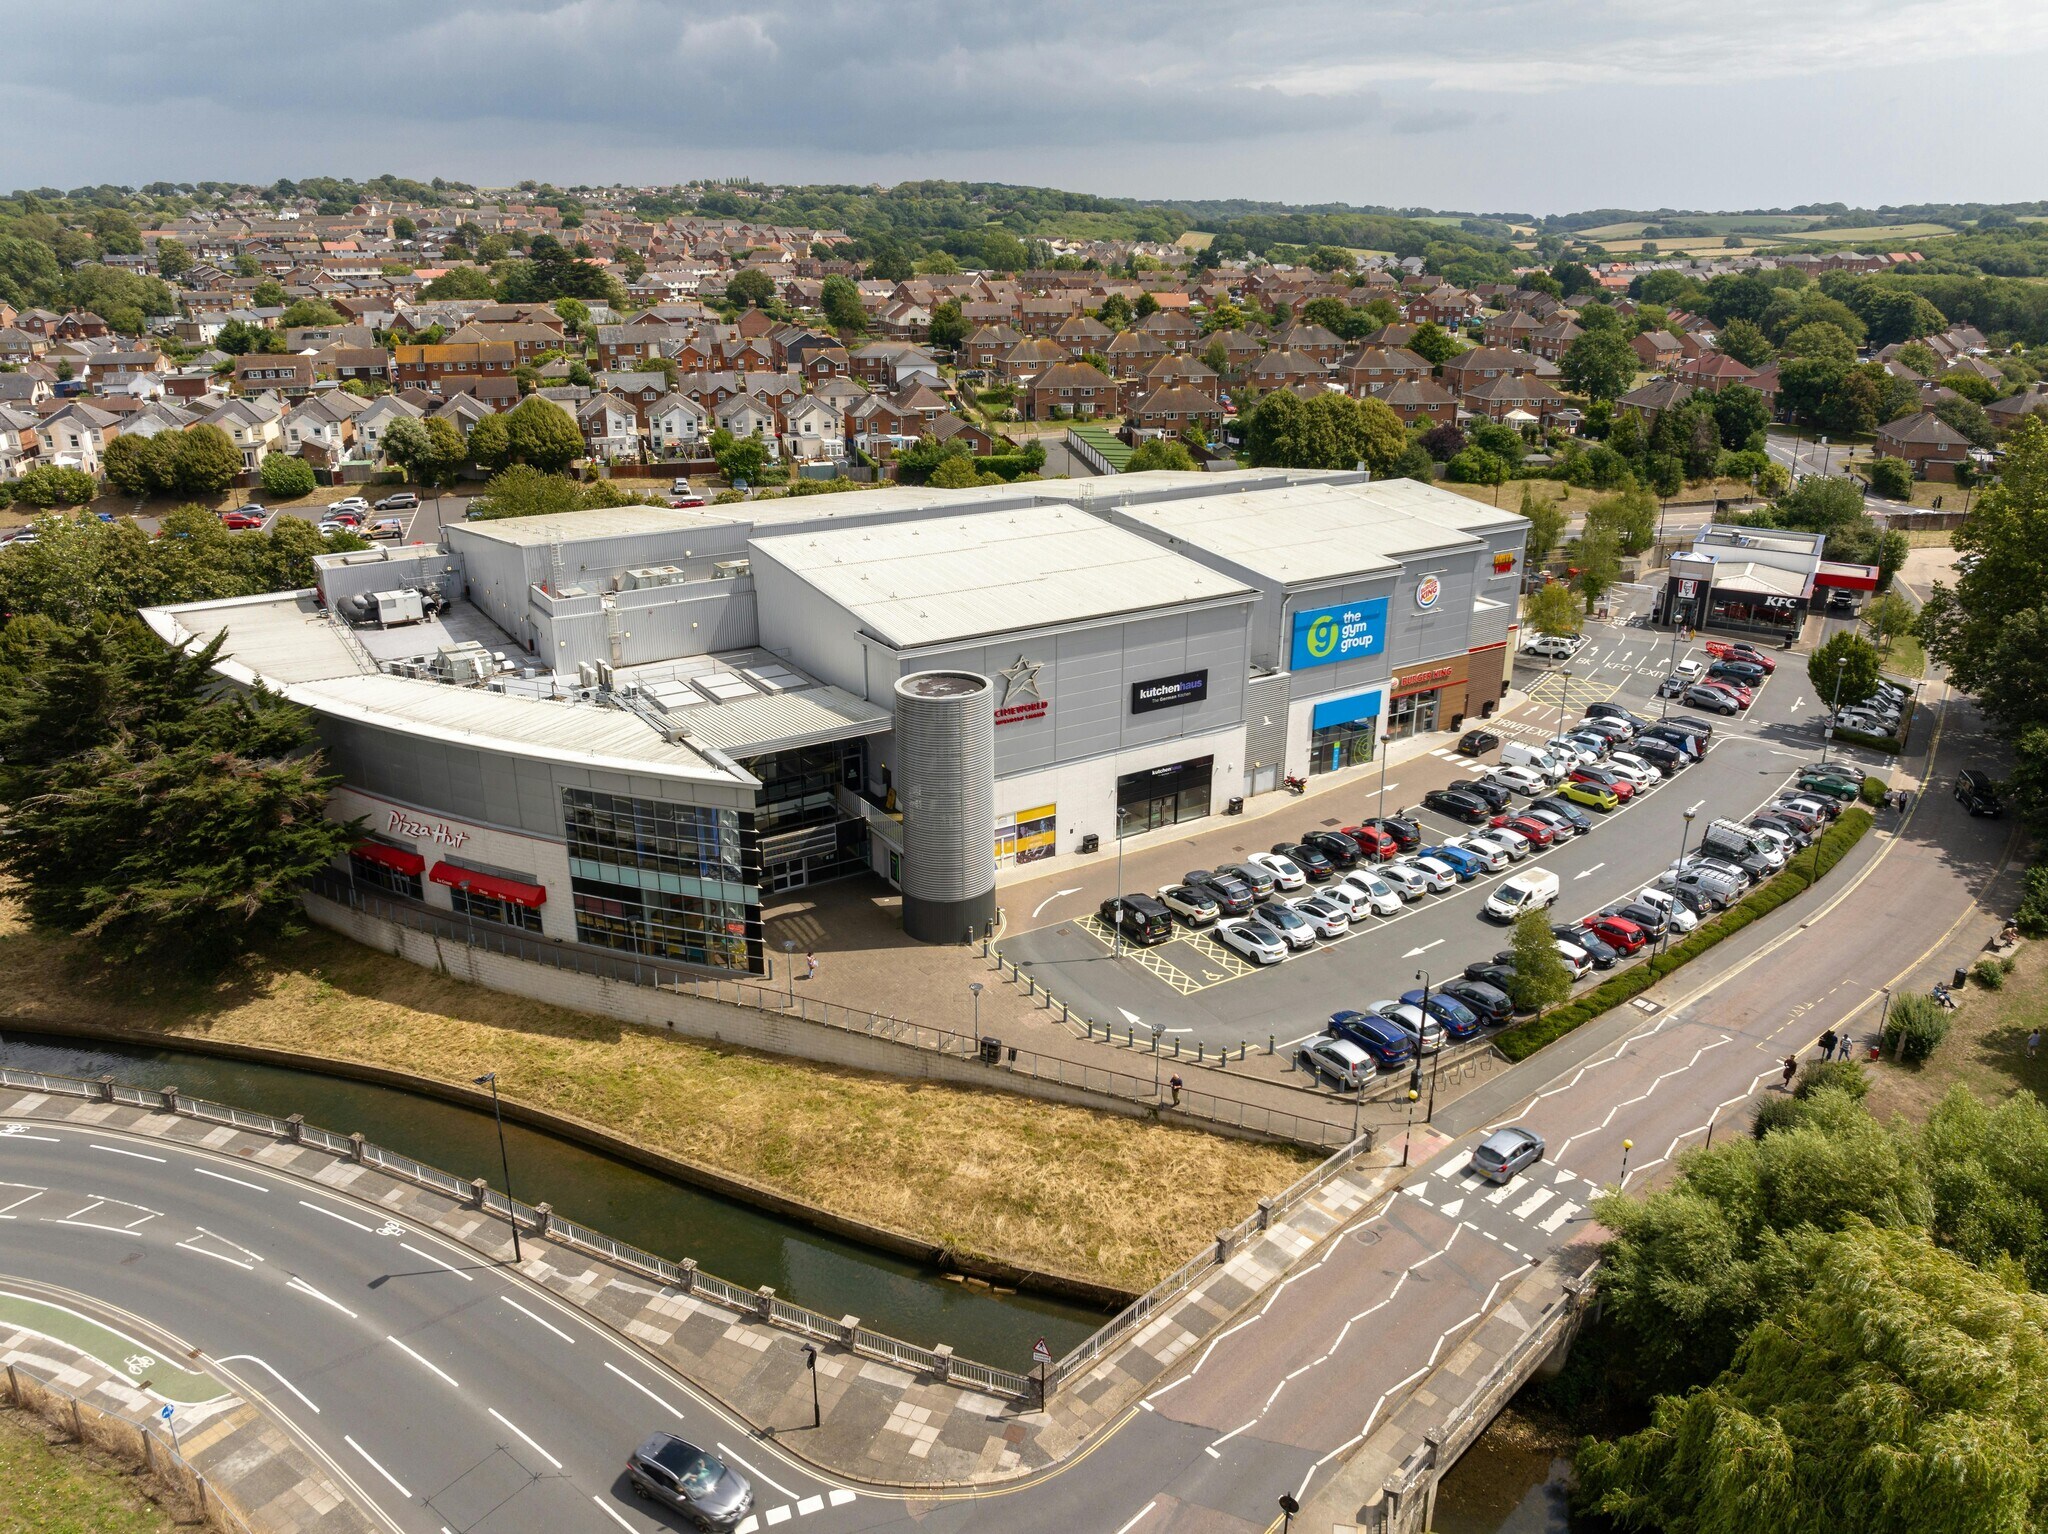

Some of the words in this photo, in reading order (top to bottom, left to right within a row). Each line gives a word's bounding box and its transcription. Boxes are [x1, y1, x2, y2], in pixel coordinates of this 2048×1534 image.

[1420, 586, 1437, 600] KING
[1764, 596, 1797, 608] KFC
[1343, 611, 1361, 623] the
[1342, 622, 1367, 638] gym
[1341, 635, 1373, 653] group
[1575, 657, 1595, 666] BK
[1604, 662, 1632, 672] KFC
[1402, 671, 1432, 686] BURGER
[1432, 667, 1453, 679] KING
[1637, 667, 1668, 678] EXIT
[994, 701, 1048, 717] CINEWORLD
[1491, 718, 1527, 732] DRIVE
[1525, 726, 1557, 738] EXIT
[387, 810, 433, 838] Pizza
[431, 823, 470, 848] Hut
